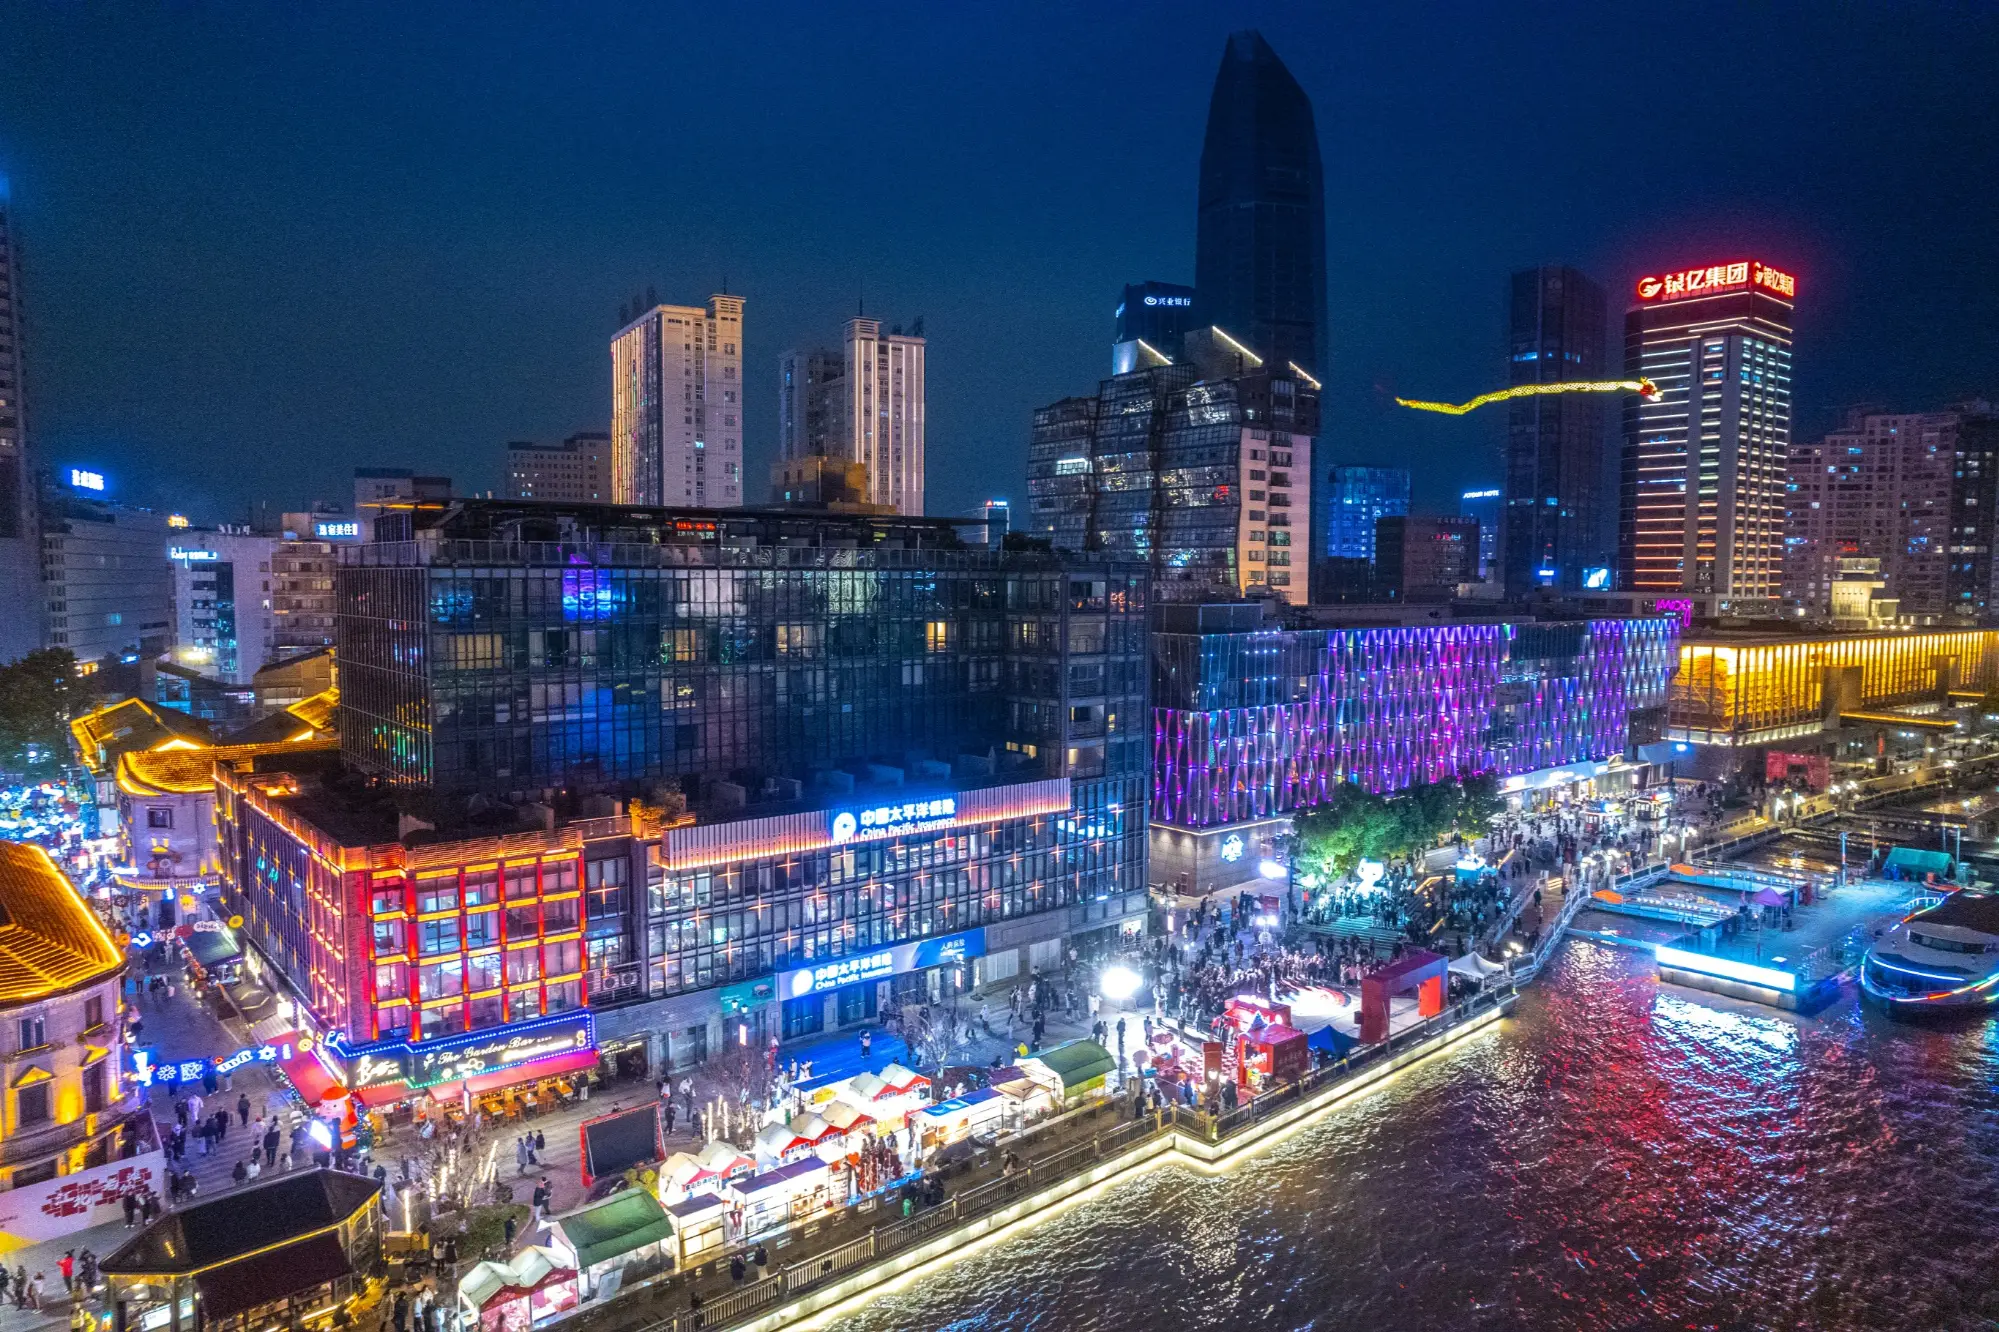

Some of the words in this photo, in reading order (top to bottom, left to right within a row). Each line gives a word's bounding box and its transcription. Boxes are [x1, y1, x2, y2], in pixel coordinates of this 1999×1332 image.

[1664, 262, 1748, 294] 银亿集团
[1158, 297, 1191, 306] 兴业银行
[861, 828, 886, 839] China
[888, 822, 915, 837] Pacific
[917, 817, 957, 832] Insurance
[815, 980, 836, 990] China
[838, 974, 860, 984] Pacific
[438, 1051, 462, 1065] The
[463, 1043, 506, 1058] Garden
[508, 1036, 535, 1048] Bar
